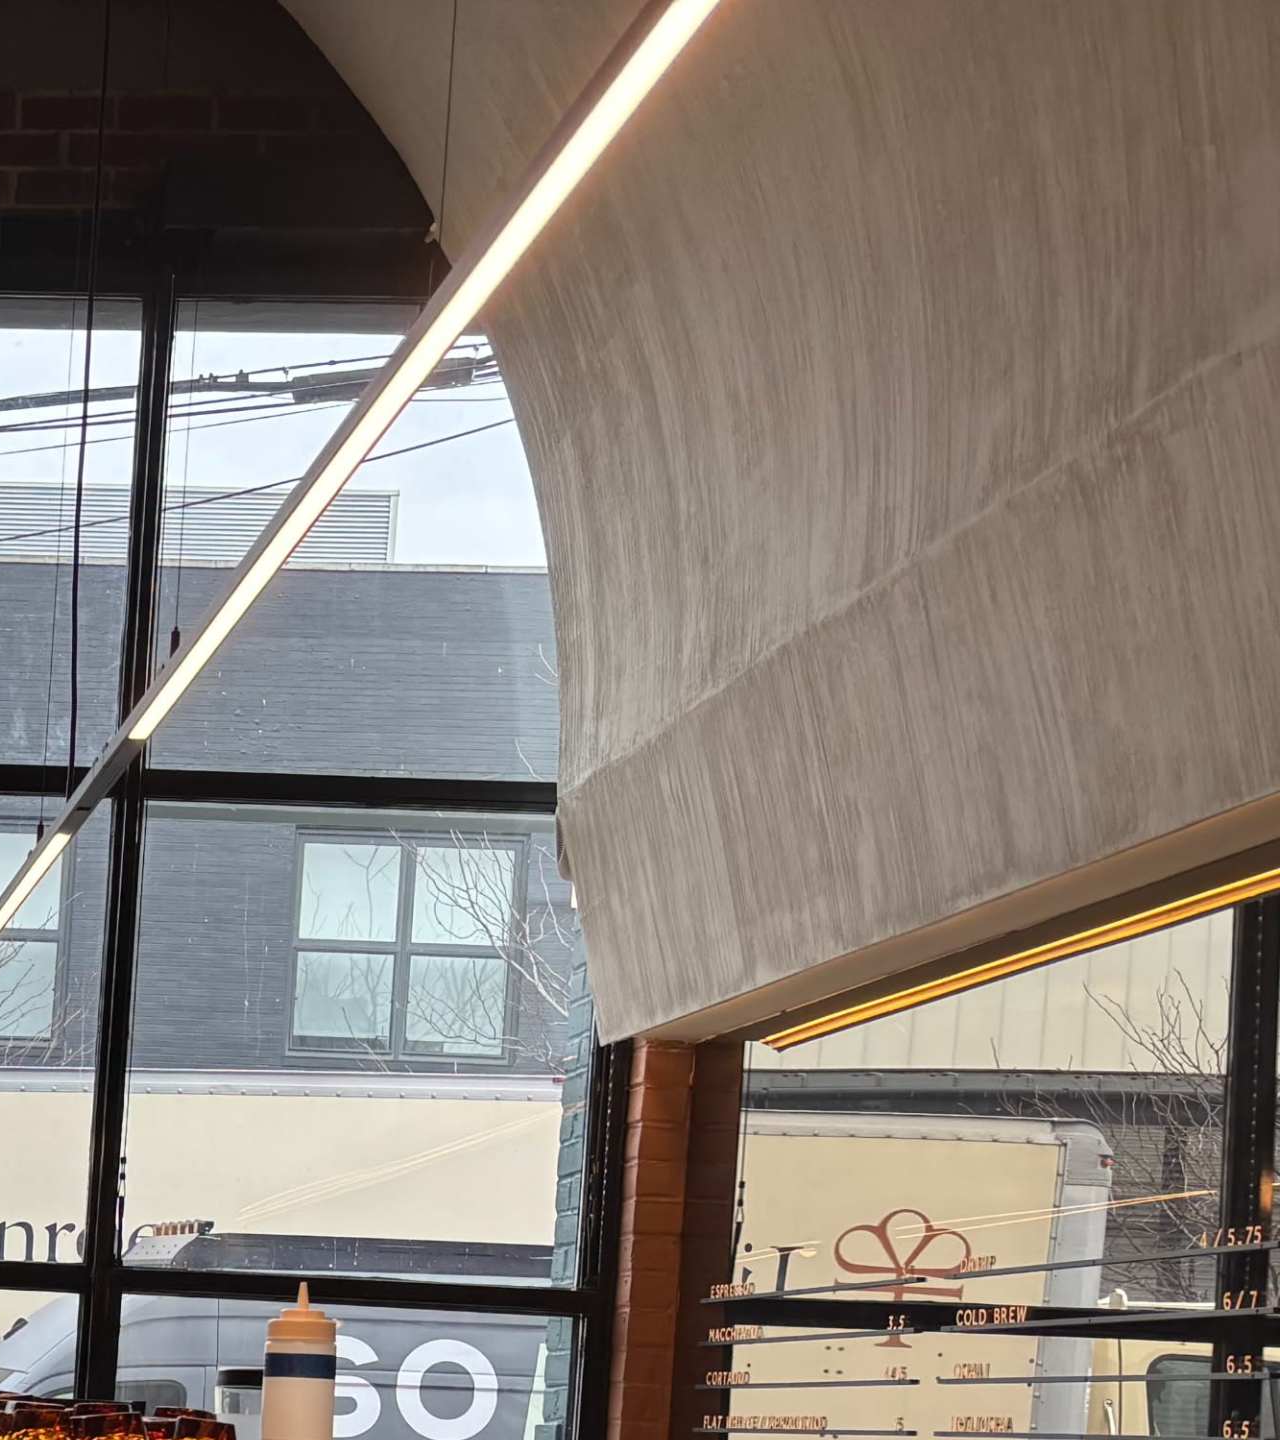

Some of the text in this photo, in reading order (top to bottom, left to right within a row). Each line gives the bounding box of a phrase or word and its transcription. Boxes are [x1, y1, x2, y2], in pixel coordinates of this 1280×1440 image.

[710, 1281, 756, 1299] ESPRESSO
[956, 1304, 1028, 1327] COLD BREW
[1226, 1354, 1252, 1375] 6.5
[703, 1415, 723, 1430] FLAT
[1222, 1420, 1250, 1439] 6.5
